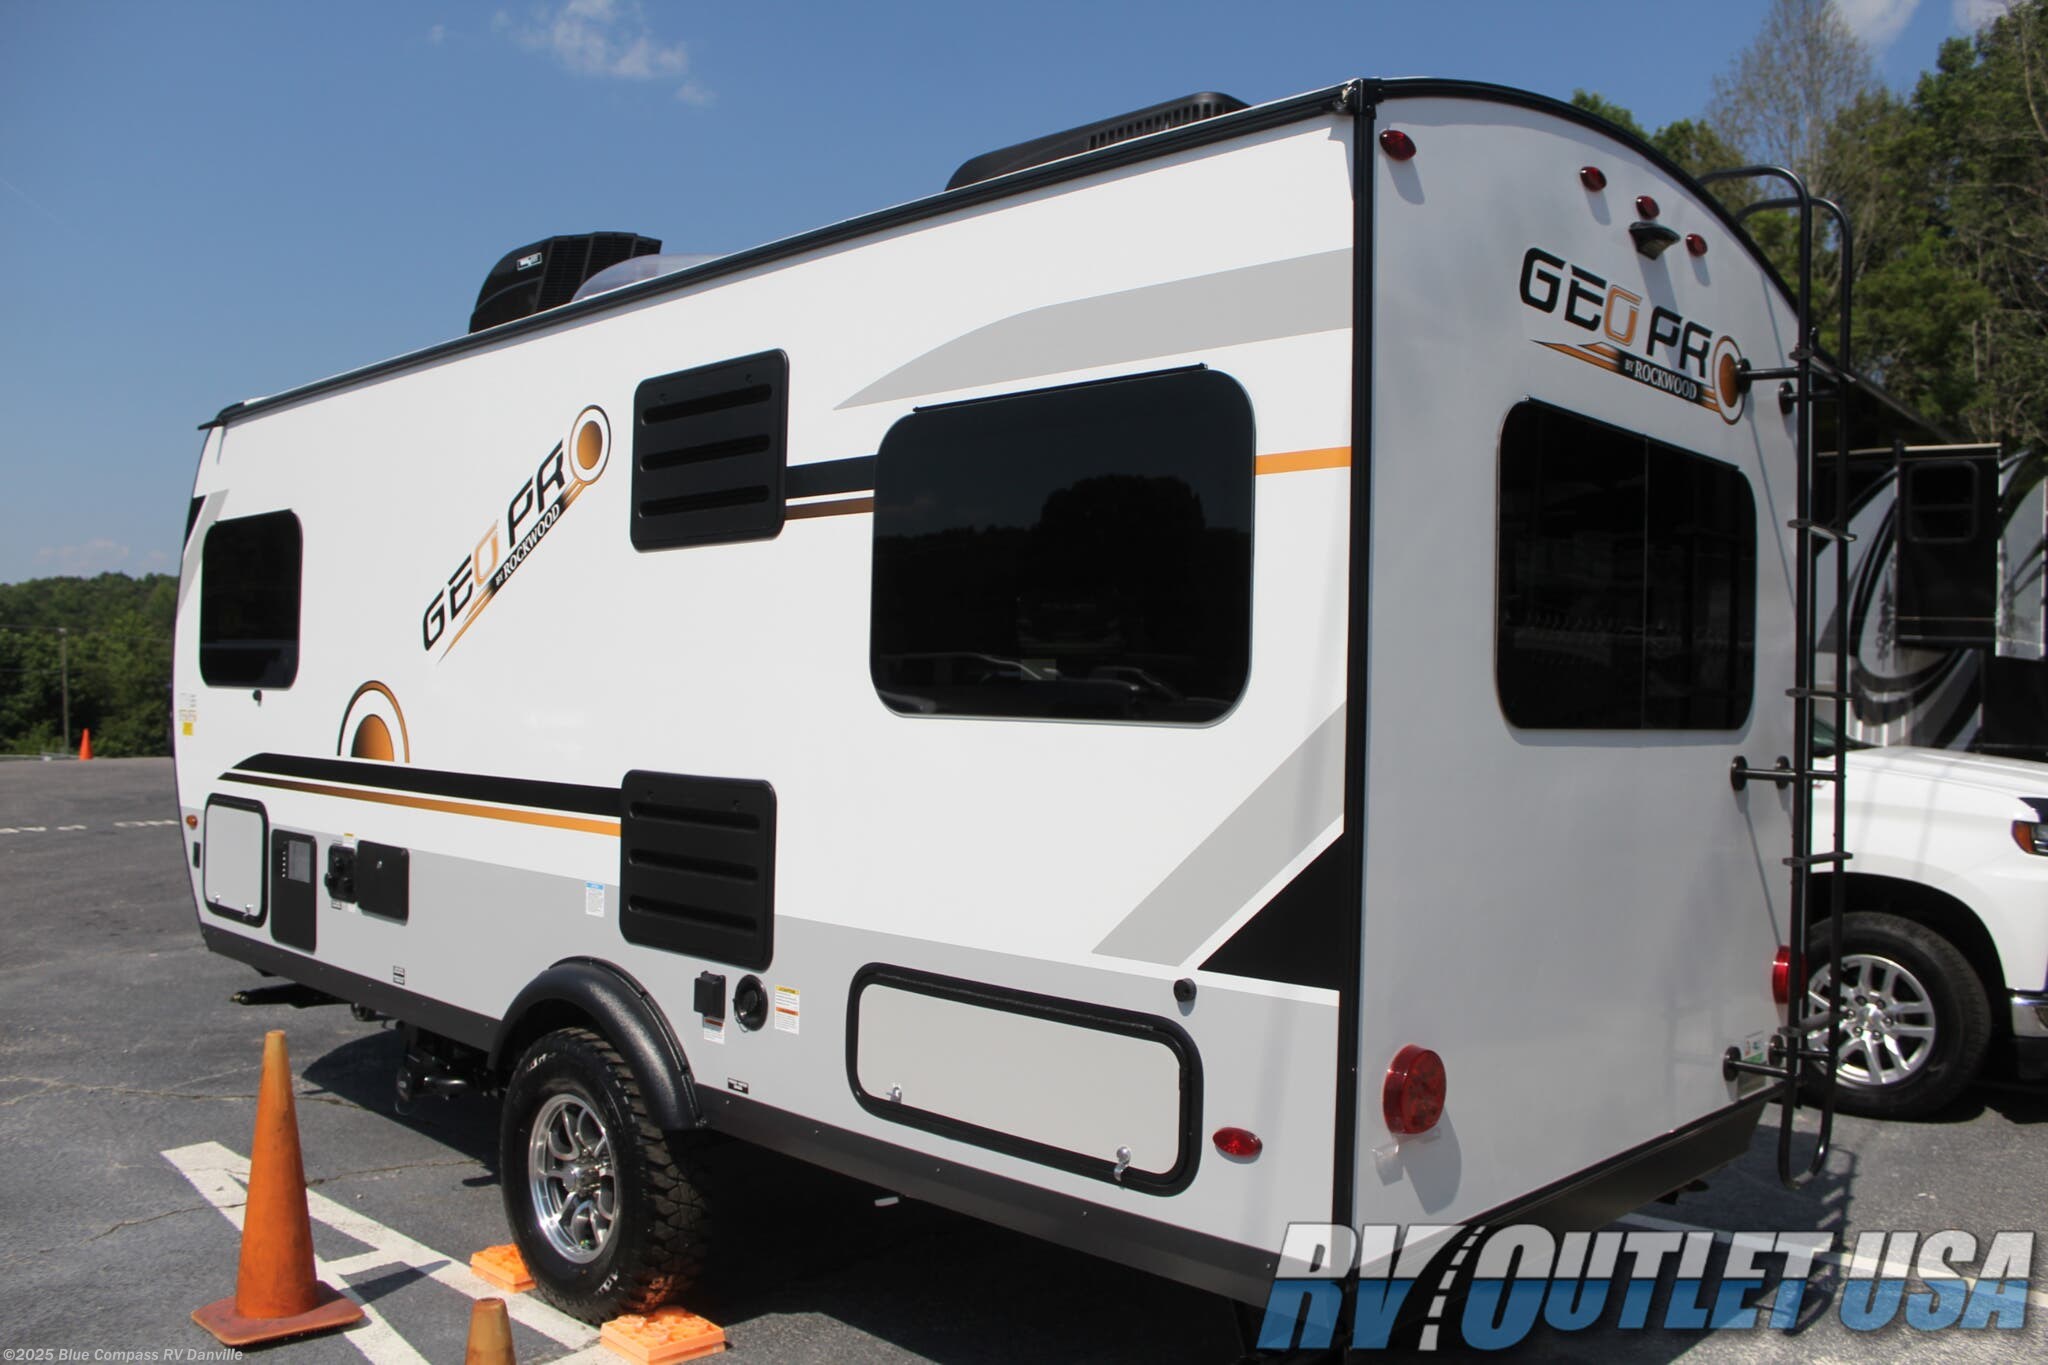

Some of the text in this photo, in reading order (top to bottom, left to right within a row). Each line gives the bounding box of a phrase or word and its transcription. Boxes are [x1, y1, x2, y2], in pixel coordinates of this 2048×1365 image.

[1519, 247, 1643, 347] GEO
[1624, 358, 1697, 400] BY ROCKWOOD
[422, 517, 499, 652] GEO
[503, 503, 561, 579] ROCKWOOD
